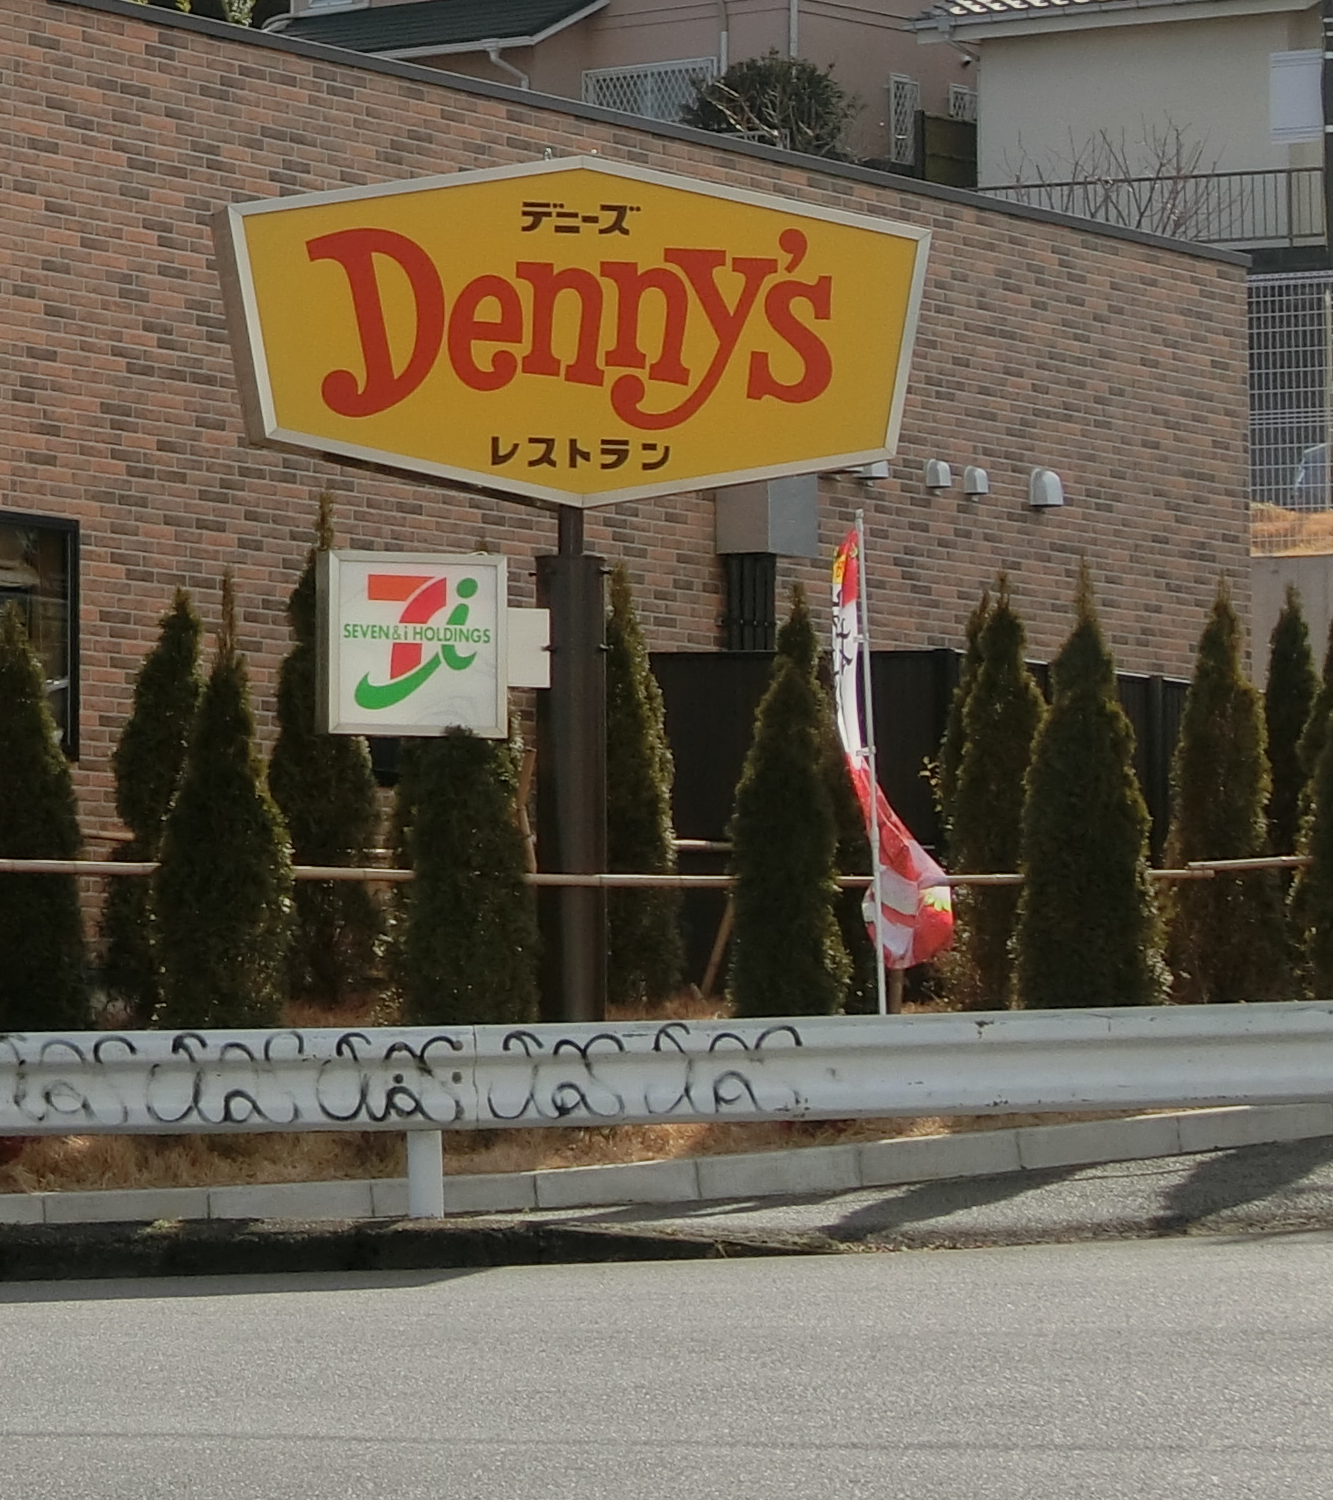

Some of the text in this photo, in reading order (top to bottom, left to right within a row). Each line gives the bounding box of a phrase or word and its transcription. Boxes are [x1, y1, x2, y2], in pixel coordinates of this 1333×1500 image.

[521, 202, 641, 236] デニーズ
[306, 228, 833, 430] Denny's
[491, 436, 670, 469] レストラン
[413, 626, 491, 644] HOLDINGS
